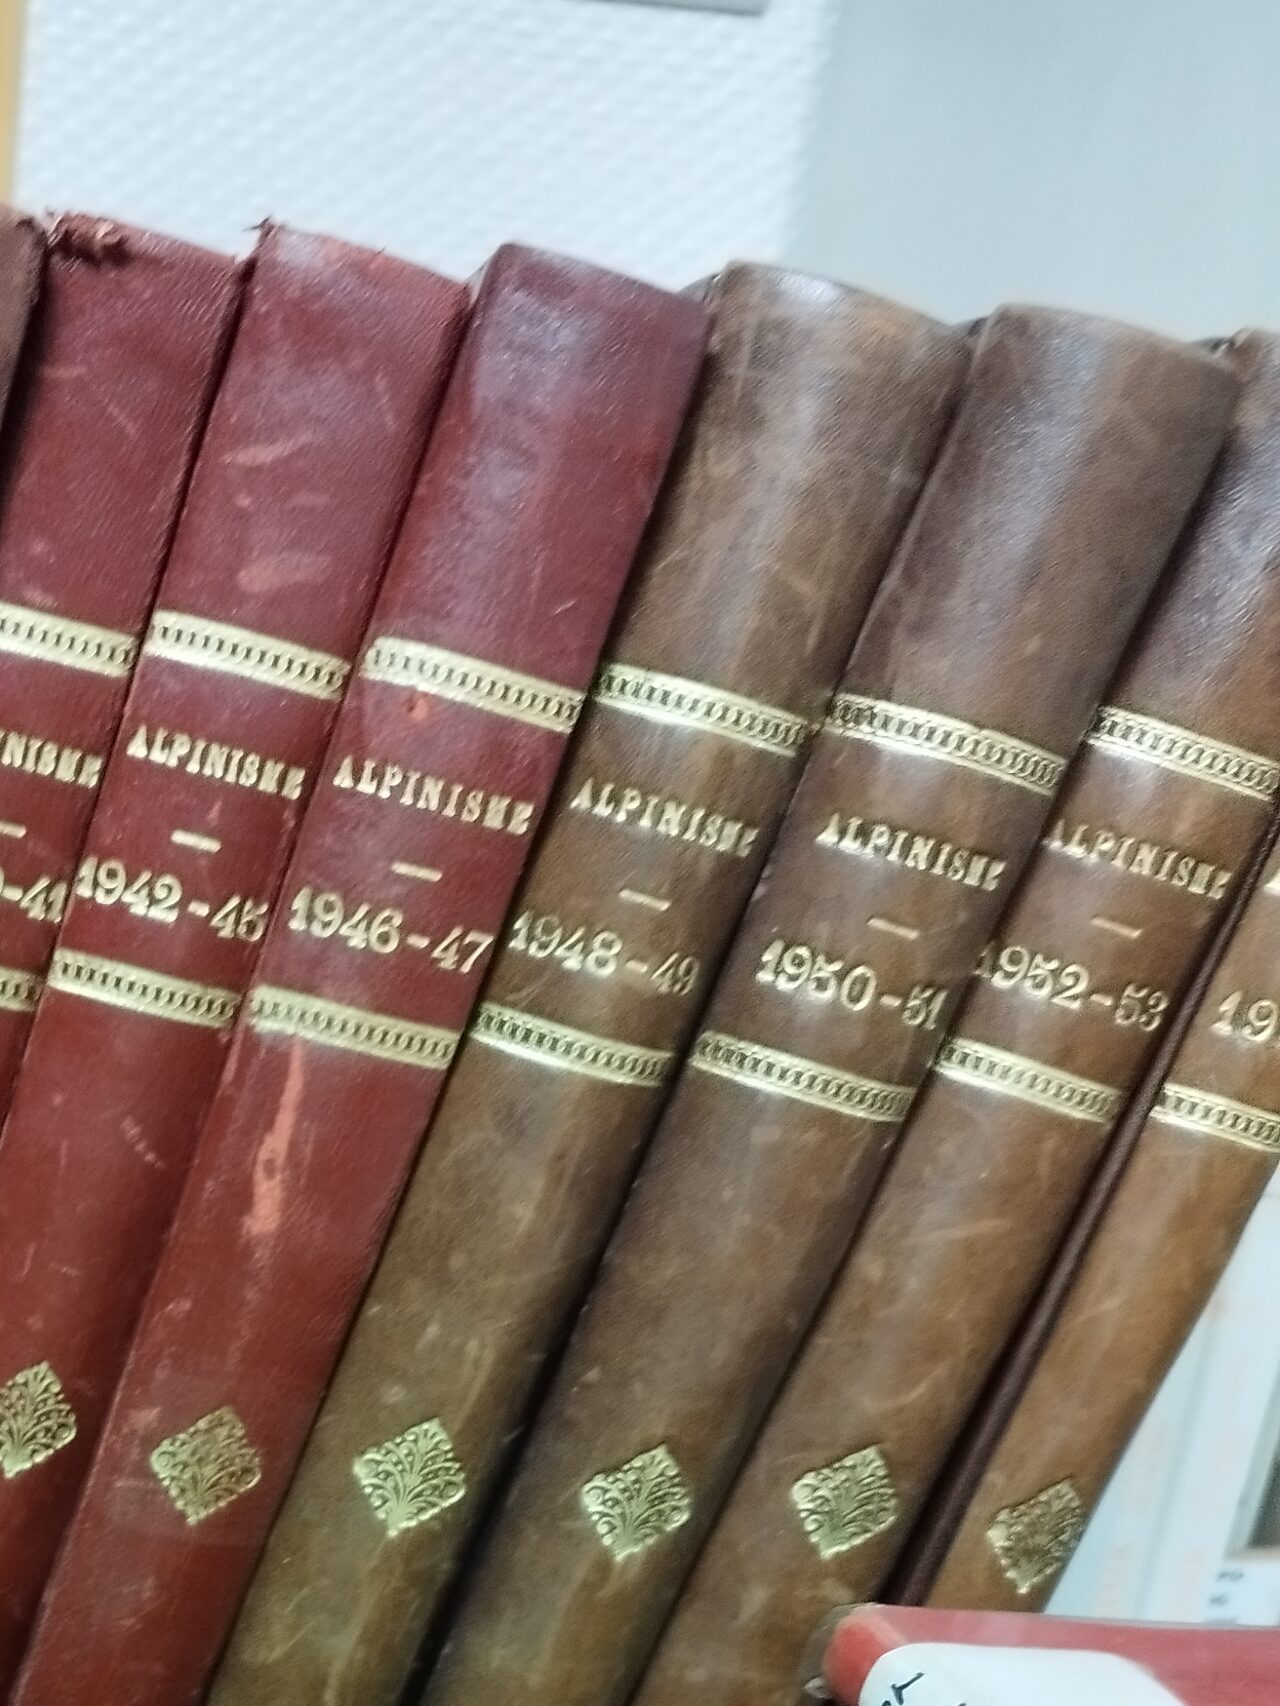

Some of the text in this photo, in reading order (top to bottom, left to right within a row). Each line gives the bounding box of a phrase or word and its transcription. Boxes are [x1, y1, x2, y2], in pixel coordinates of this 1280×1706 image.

[127, 725, 306, 800] ALPINISME
[334, 755, 534, 835] ALPINISME
[571, 776, 758, 856] ALPINISME
[817, 812, 1006, 892] ALPINISME
[77, 857, 268, 943] 1942-45
[1046, 819, 1232, 900] ALPINISME
[288, 886, 494, 975] 1946-47
[509, 911, 700, 996] 1948-49
[755, 938, 948, 1030] 1950-51
[973, 940, 1170, 1032] 1952-53
[1211, 990, 1280, 1042] 19
